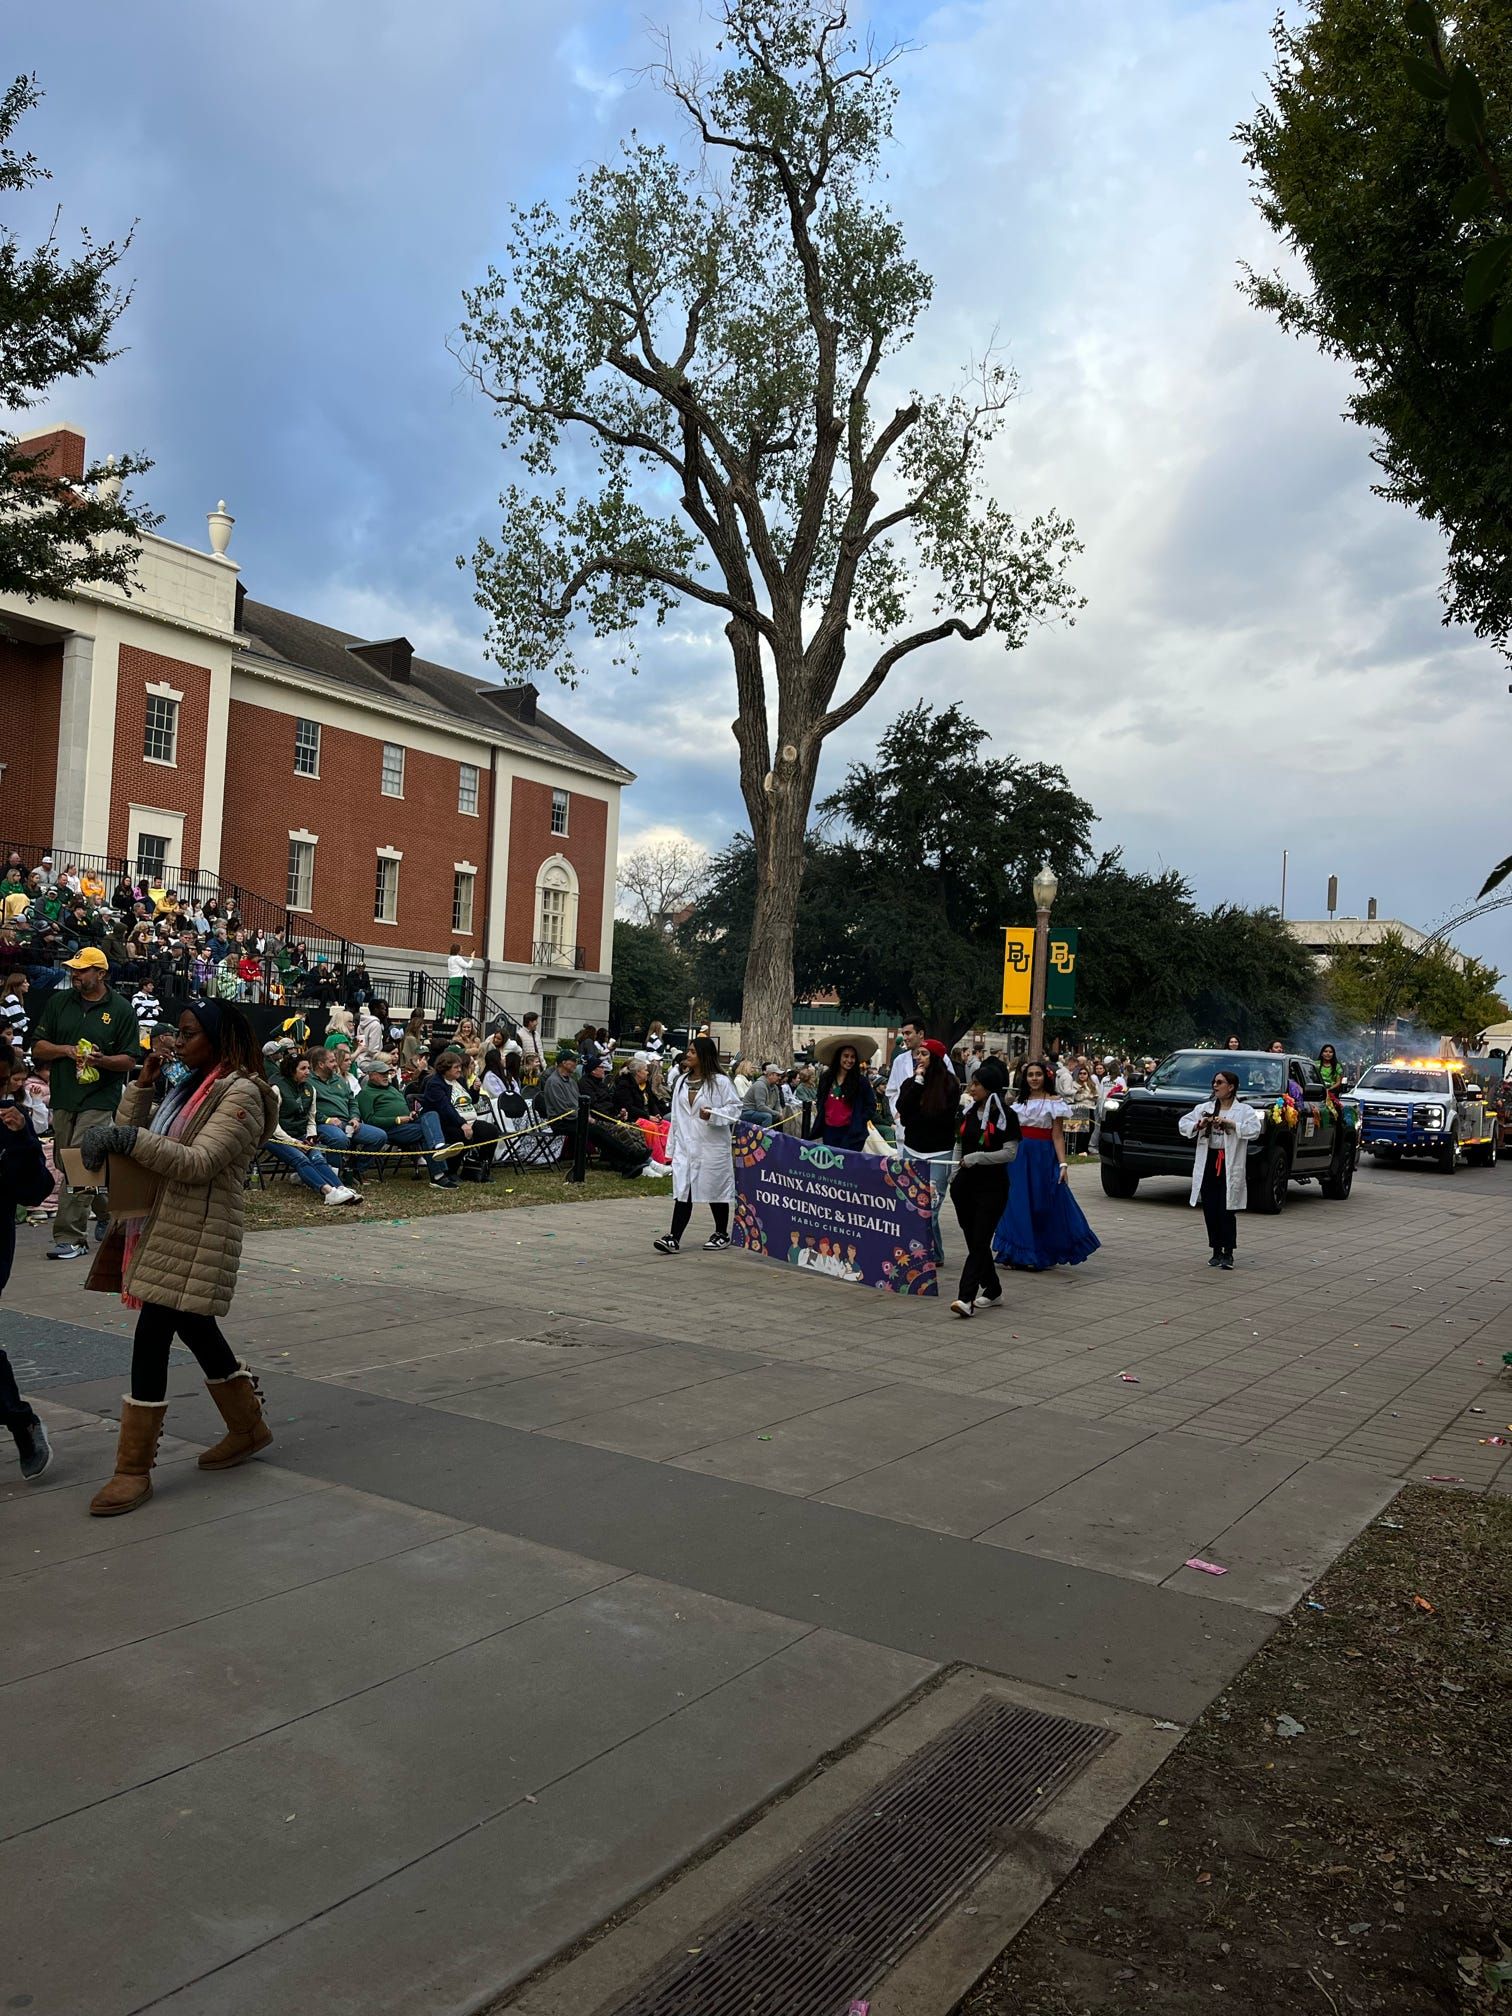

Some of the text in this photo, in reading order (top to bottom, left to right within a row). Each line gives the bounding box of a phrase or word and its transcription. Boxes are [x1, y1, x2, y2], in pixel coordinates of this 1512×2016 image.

[1007, 942, 1030, 972] BU
[1050, 942, 1075, 973] BU
[788, 1168, 816, 1179] BAYLOR
[760, 1169, 897, 1212] LATINX ASSOCIATION
[755, 1189, 901, 1237] FOR SCIENCE & HEALTH
[791, 1215, 862, 1239] HABLO CIENCIA
